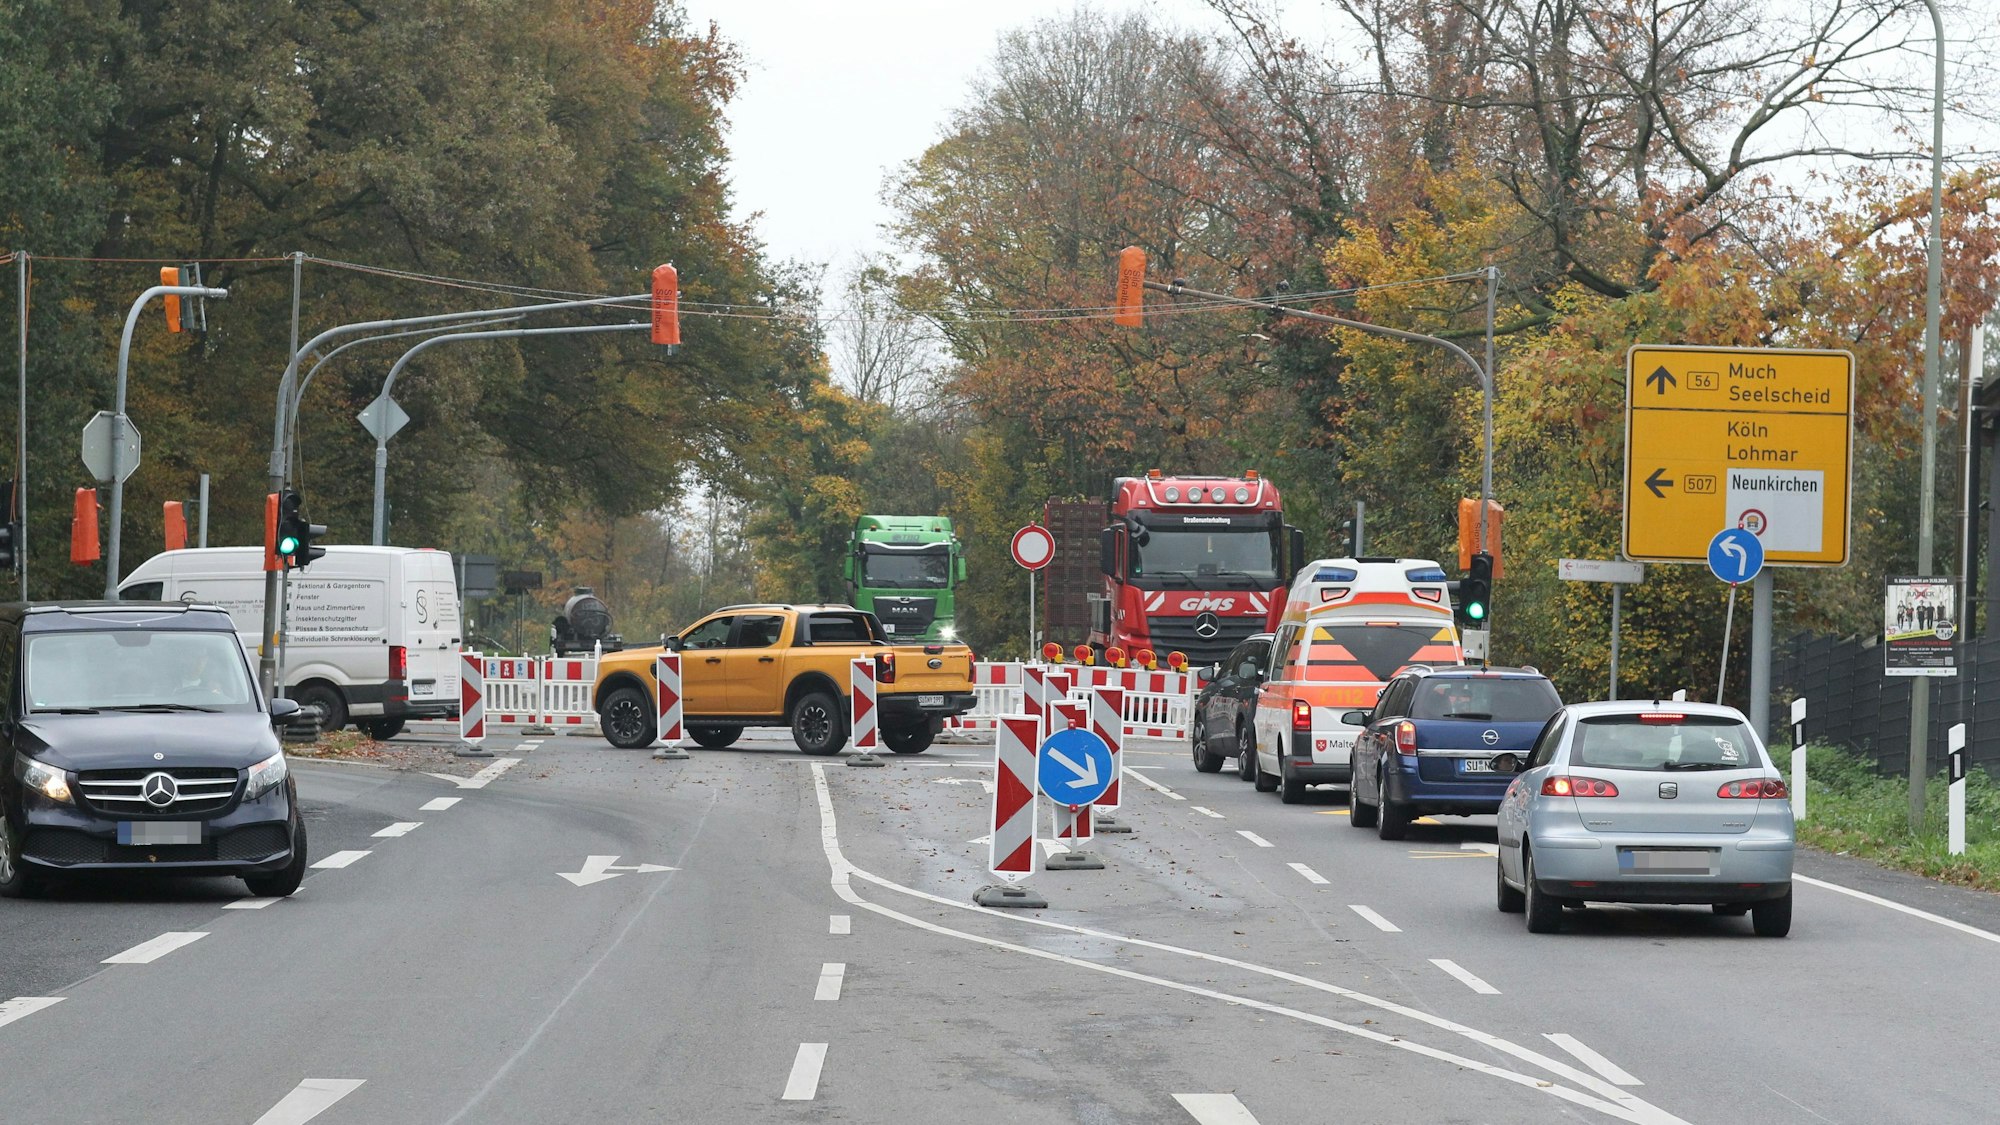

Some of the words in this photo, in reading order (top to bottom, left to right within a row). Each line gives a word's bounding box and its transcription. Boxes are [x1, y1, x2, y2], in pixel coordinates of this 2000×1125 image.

[1729, 363, 1776, 379] Much
[1695, 375, 1711, 387] 56
[1729, 386, 1830, 404] Seelscheid
[1728, 421, 1768, 438] Köln
[1727, 445, 1798, 462] Lohmar
[1688, 478, 1712, 491] 507
[1732, 474, 1818, 492] Neunkirchen
[1180, 598, 1235, 611] GMS
[885, 624, 892, 632] A
[330, 635, 380, 643] Schranklösungen
[1335, 688, 1364, 703] 112
[1329, 739, 1354, 748] Malte
[1466, 759, 1478, 771] SU
